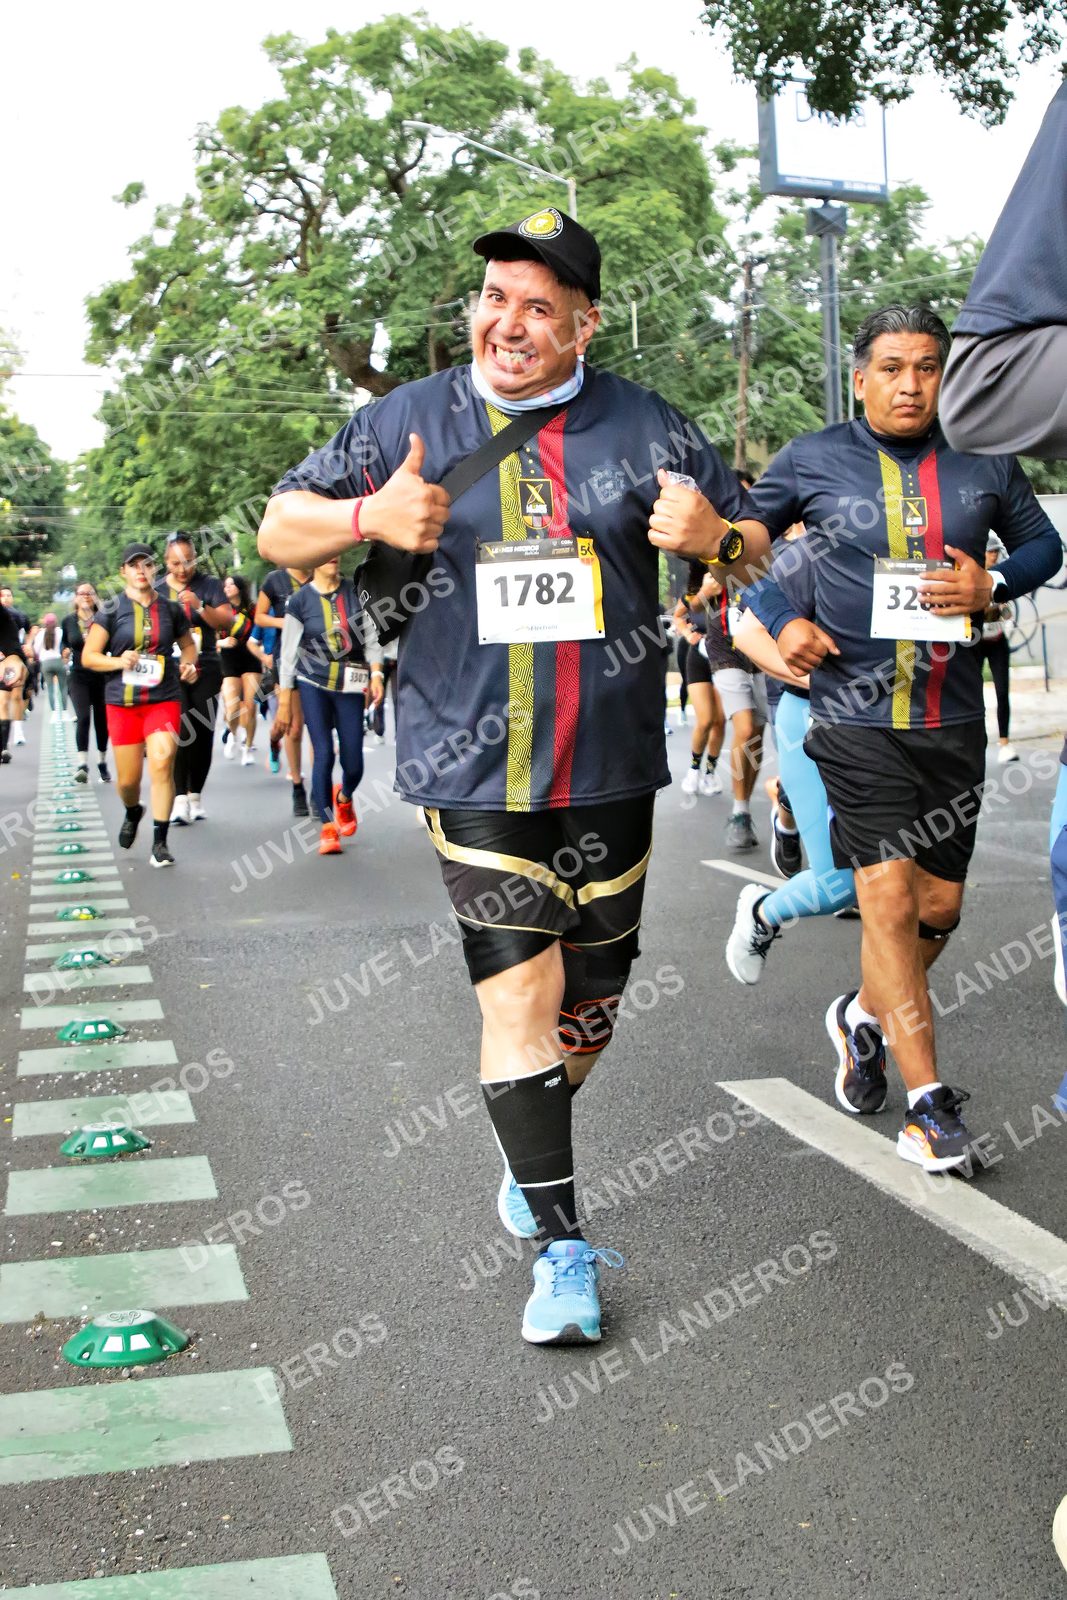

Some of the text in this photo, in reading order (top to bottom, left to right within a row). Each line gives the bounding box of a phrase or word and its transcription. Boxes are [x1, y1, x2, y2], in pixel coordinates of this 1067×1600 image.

[493, 572, 575, 607] 1782
[886, 585, 944, 612] 32
[135, 663, 155, 675] 051
